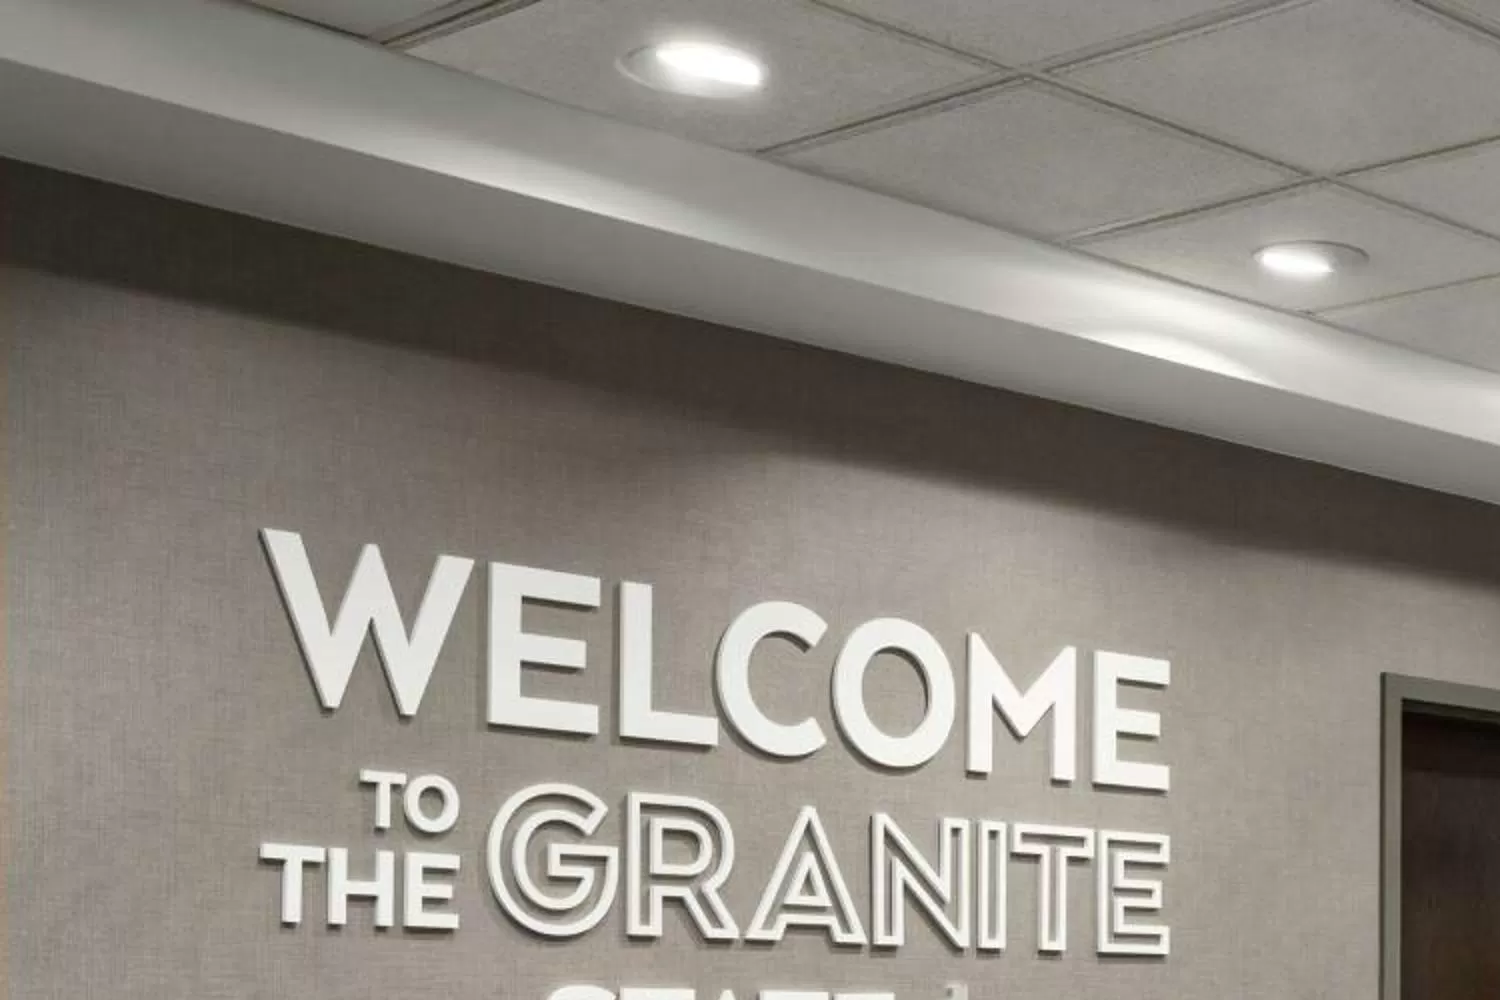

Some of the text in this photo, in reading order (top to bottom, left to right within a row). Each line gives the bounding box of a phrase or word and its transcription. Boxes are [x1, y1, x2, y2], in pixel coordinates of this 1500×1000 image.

[259, 527, 1172, 791] WELCOME
[260, 782, 1171, 957] THE GRANITE
[360, 769, 460, 833] TO
